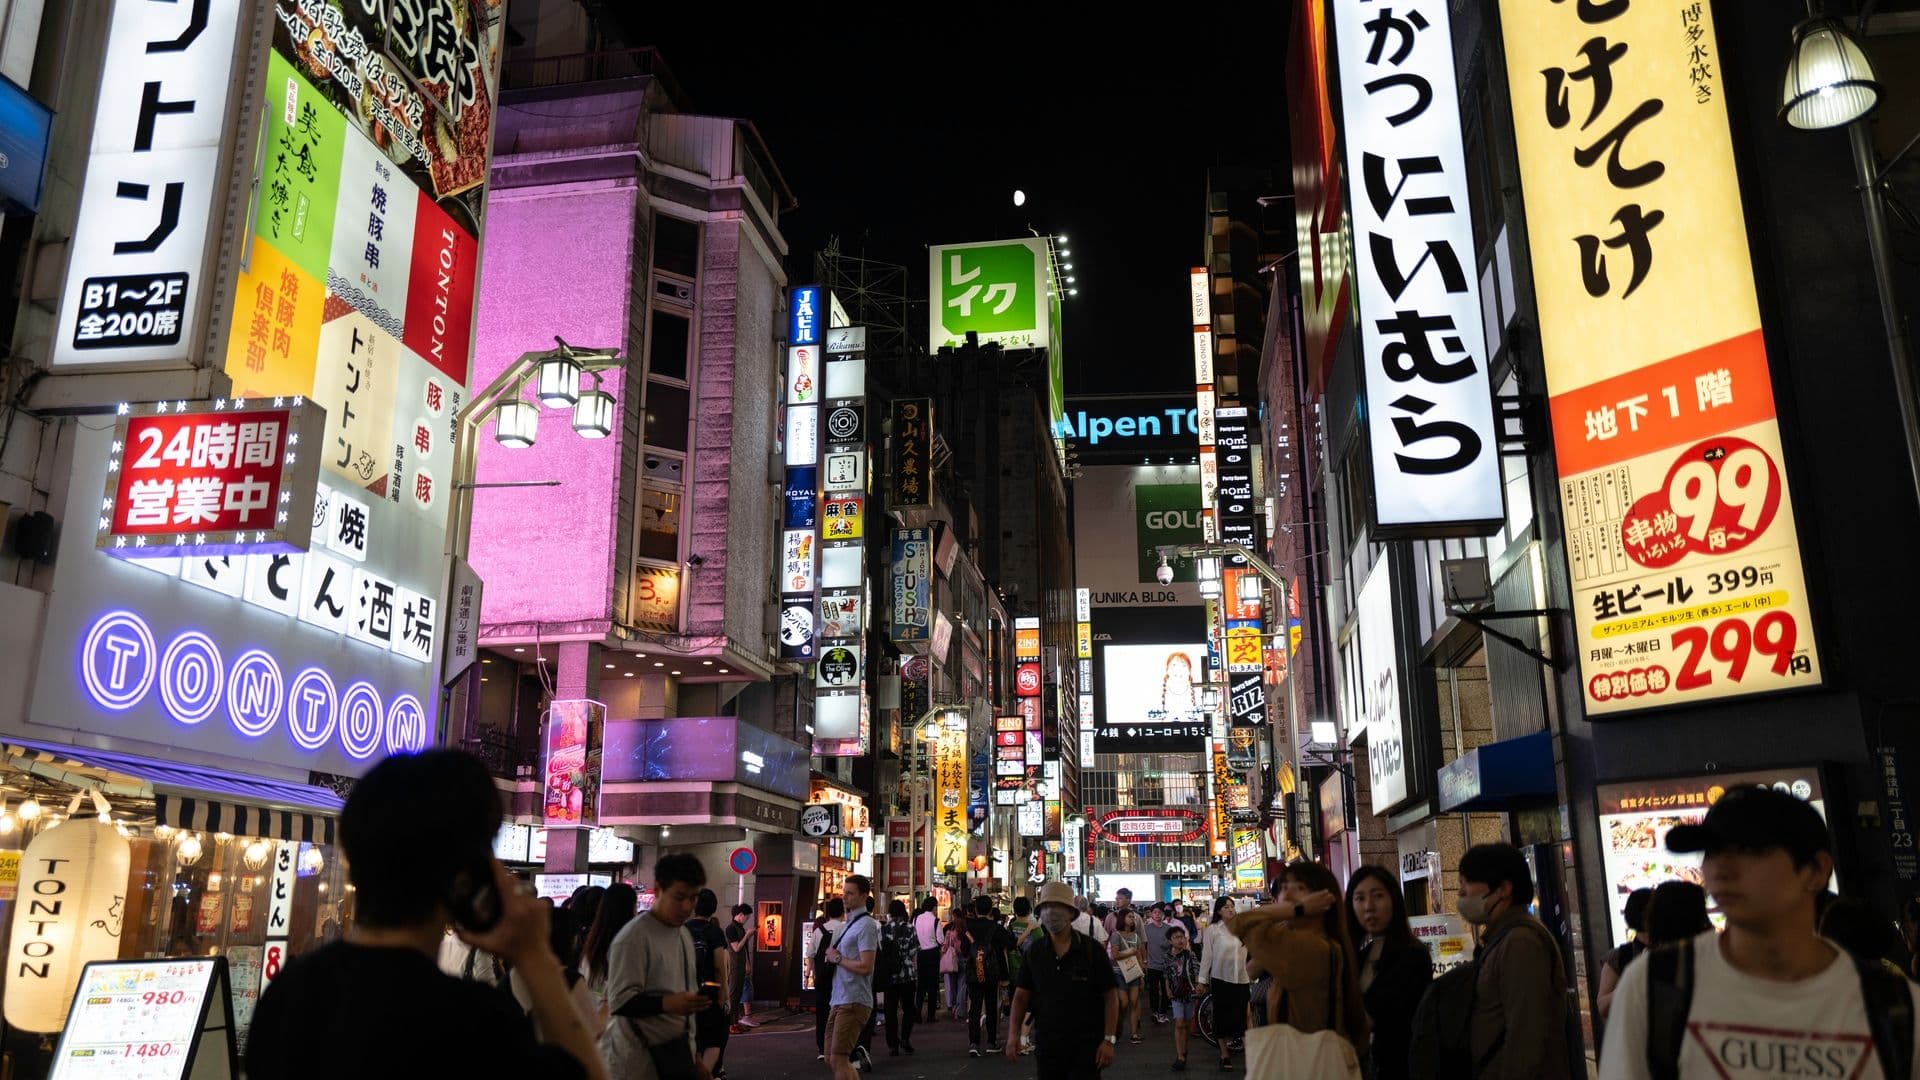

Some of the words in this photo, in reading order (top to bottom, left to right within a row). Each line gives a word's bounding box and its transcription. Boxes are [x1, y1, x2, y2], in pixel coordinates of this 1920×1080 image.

[311, 39, 364, 102] 全120席
[1681, 2, 1714, 105] 博多水炊き
[363, 183, 388, 271] 焼豚串
[1362, 0, 1483, 475] かつにいむら
[271, 266, 301, 360] 焼豚肉
[429, 228, 456, 361] TONTON
[796, 289, 814, 342] JAビル
[77, 309, 180, 340] 全200席
[336, 326, 366, 470] トントン
[131, 420, 281, 471] 24時間
[125, 474, 271, 527] 営業中
[785, 489, 816, 497] ROYAL
[825, 502, 858, 518] 麻雀
[338, 501, 367, 551] 焼
[898, 529, 923, 542] 麻雀
[1626, 510, 1678, 548] 串物
[1637, 534, 1687, 564] いろいろ
[455, 584, 474, 658] 劇場通り一番街
[1593, 576, 1694, 622] 生ビール
[900, 627, 920, 640] 4F
[1017, 638, 1039, 648] ZINO
[98, 625, 421, 752] TONTON
[1592, 668, 1666, 698] 特別価格
[998, 717, 1022, 727] ZINO
[1121, 820, 1183, 833] 歌舞伎町一番街
[1891, 832, 1913, 849] 23
[269, 839, 292, 929] きとん
[1165, 861, 1206, 875] Alpen
[18, 858, 71, 979] TONTON
[142, 990, 185, 1006] 980
[1720, 1036, 1846, 1080] GUESS
